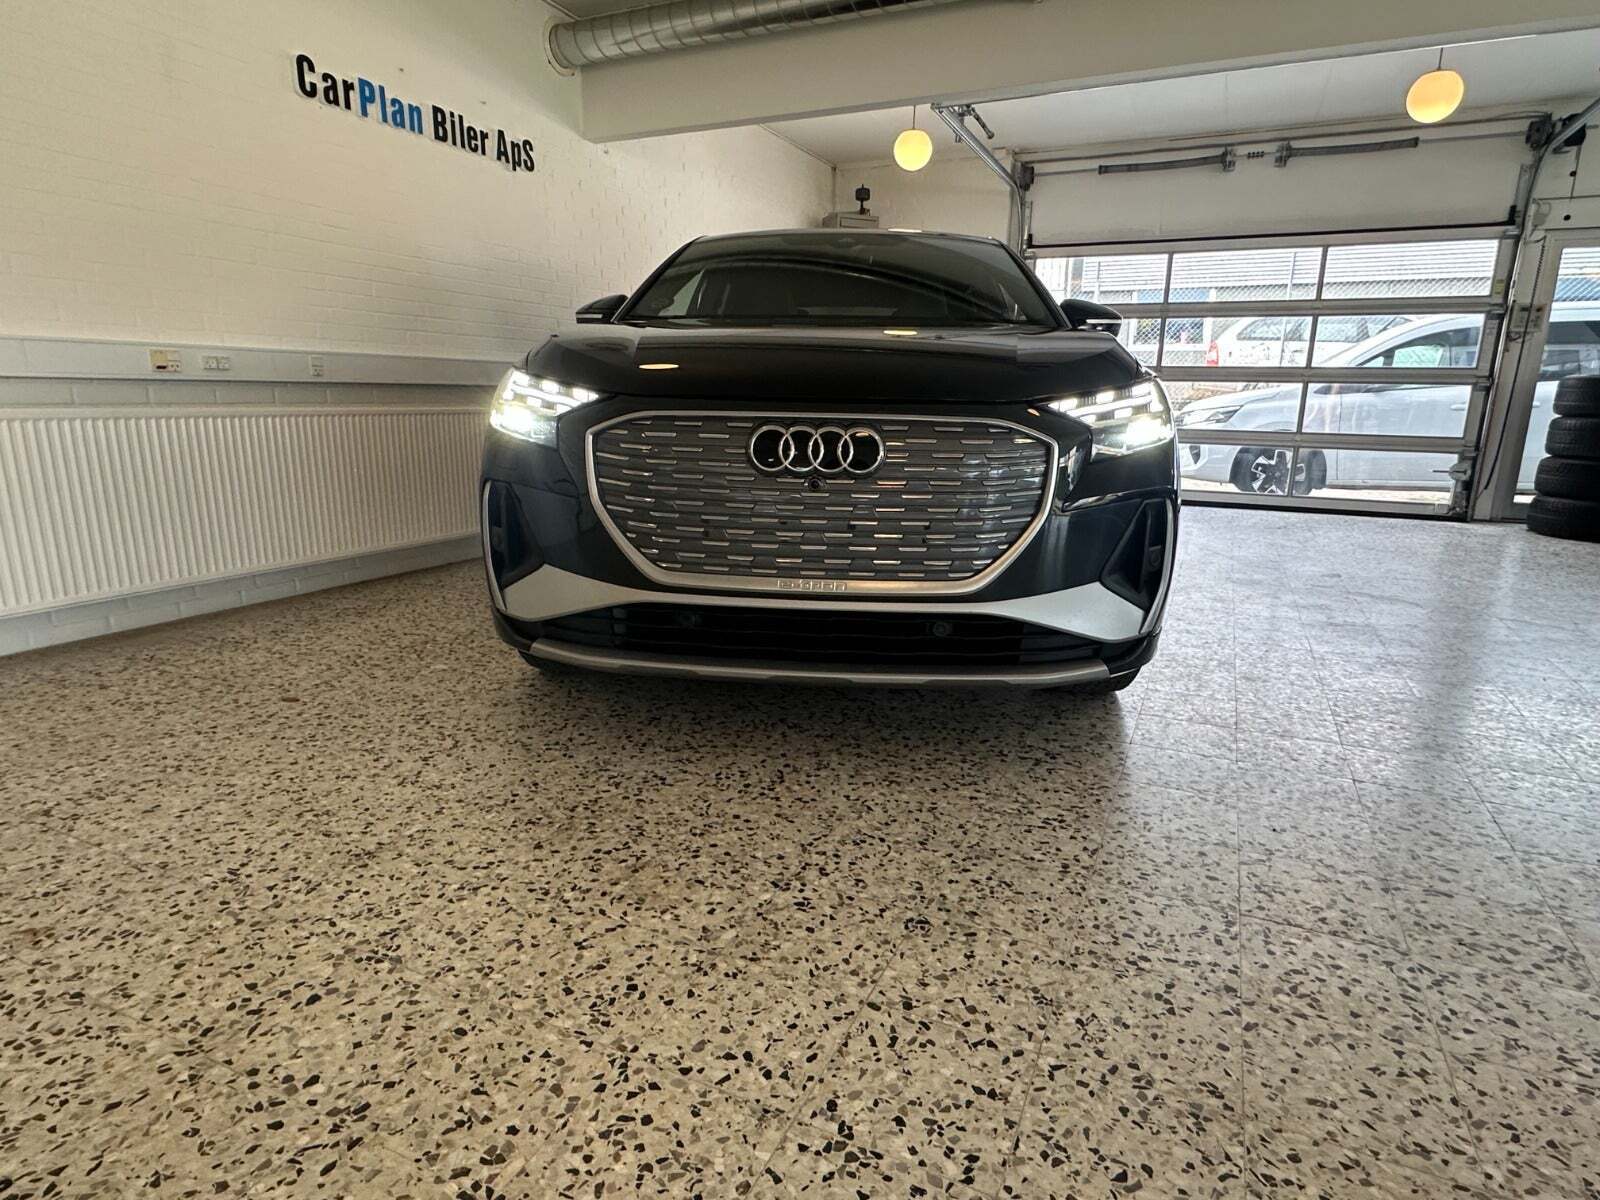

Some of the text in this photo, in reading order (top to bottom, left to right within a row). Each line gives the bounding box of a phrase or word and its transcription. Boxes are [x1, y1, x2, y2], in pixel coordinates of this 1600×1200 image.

[295, 54, 536, 172] CarPlan Biler ApS
